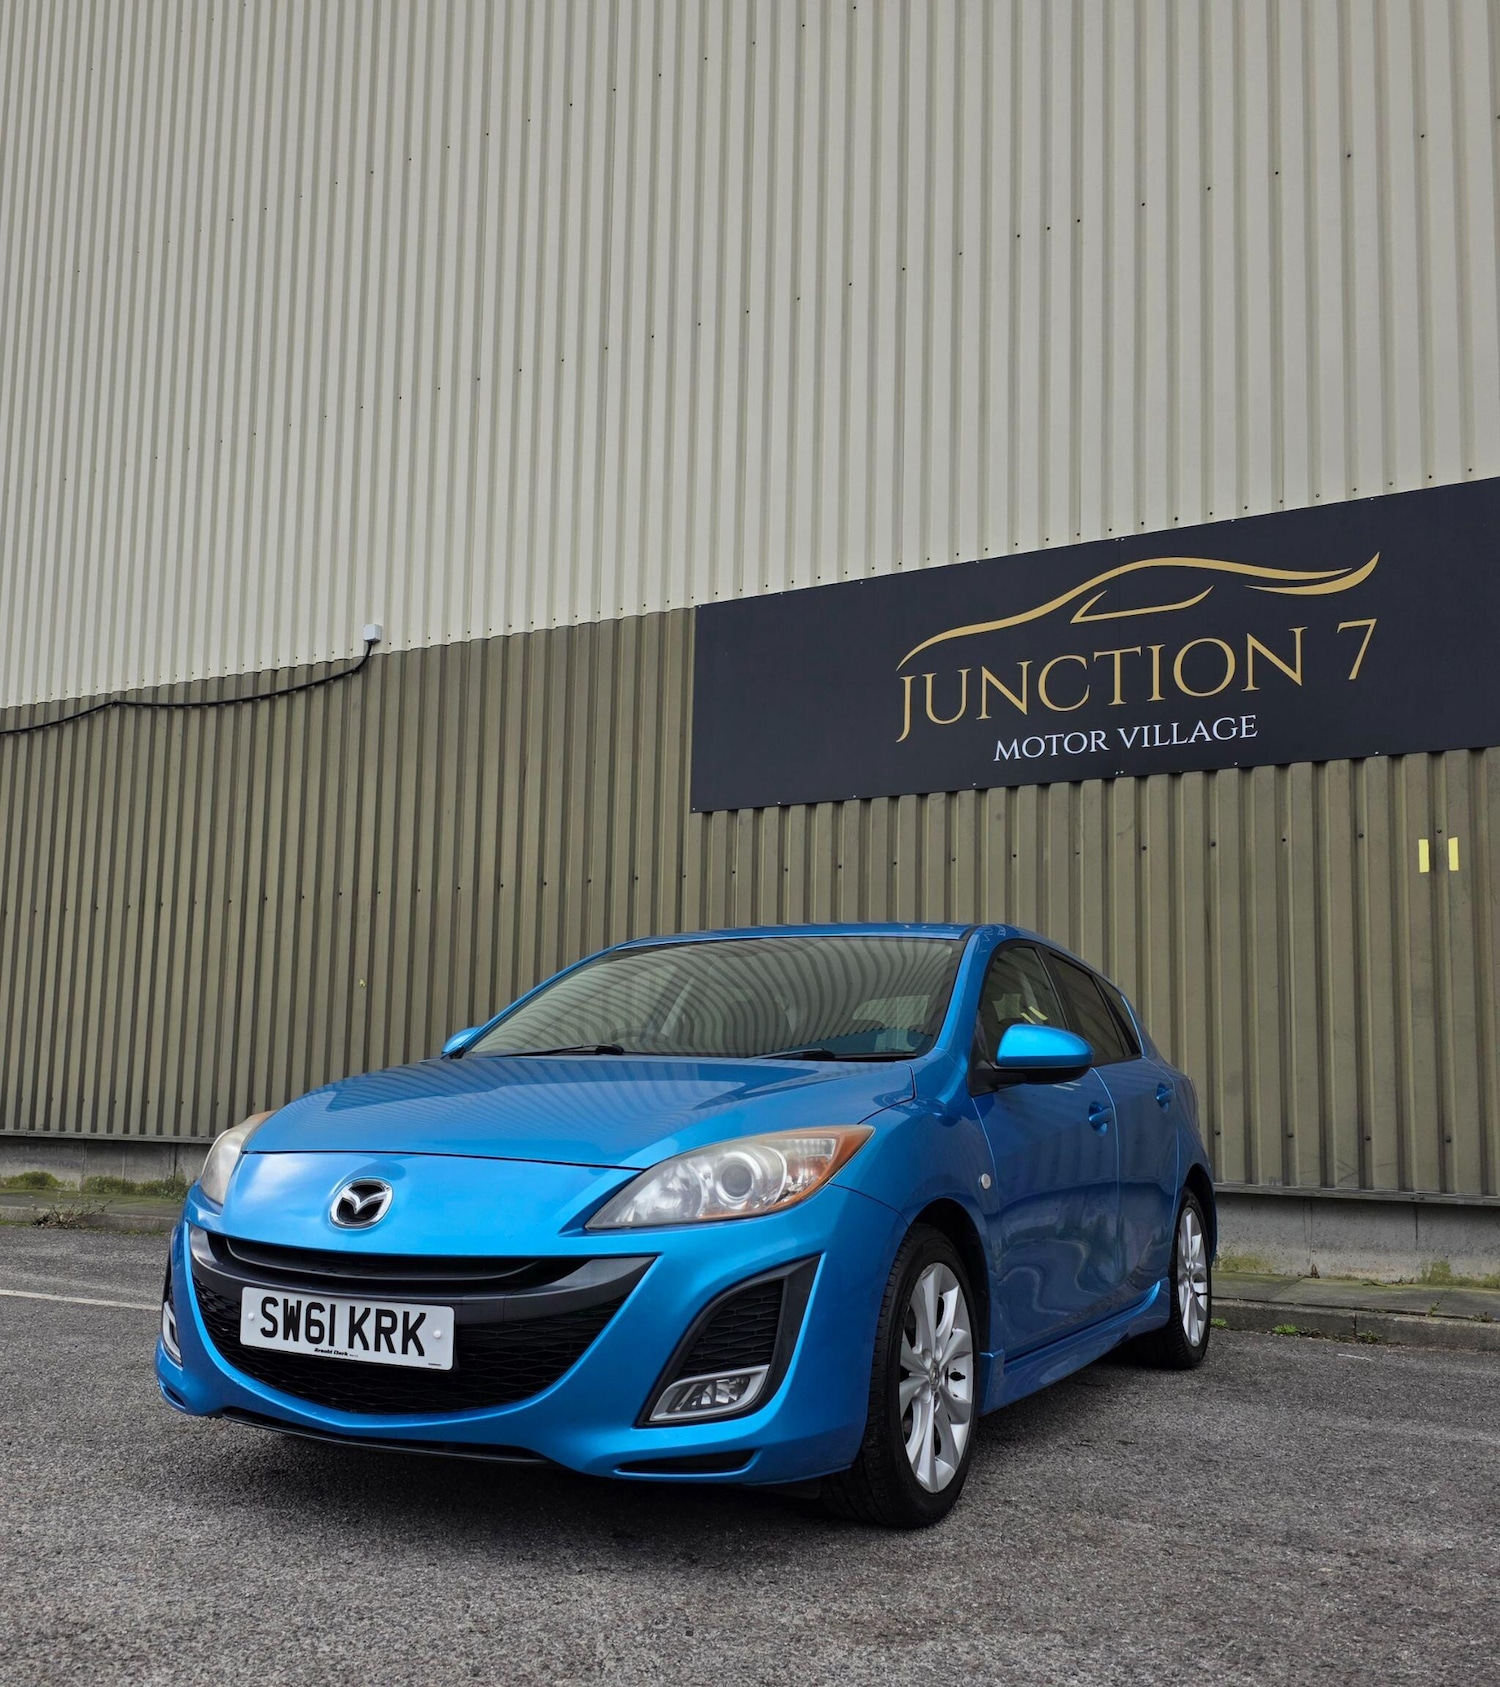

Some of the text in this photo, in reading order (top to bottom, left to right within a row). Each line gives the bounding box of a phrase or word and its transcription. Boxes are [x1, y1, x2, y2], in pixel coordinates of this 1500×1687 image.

[896, 618, 1378, 743] JUNCTION 7
[993, 714, 1259, 762] MOTOR VILLAGE
[260, 1296, 427, 1357] SW61 KRK
